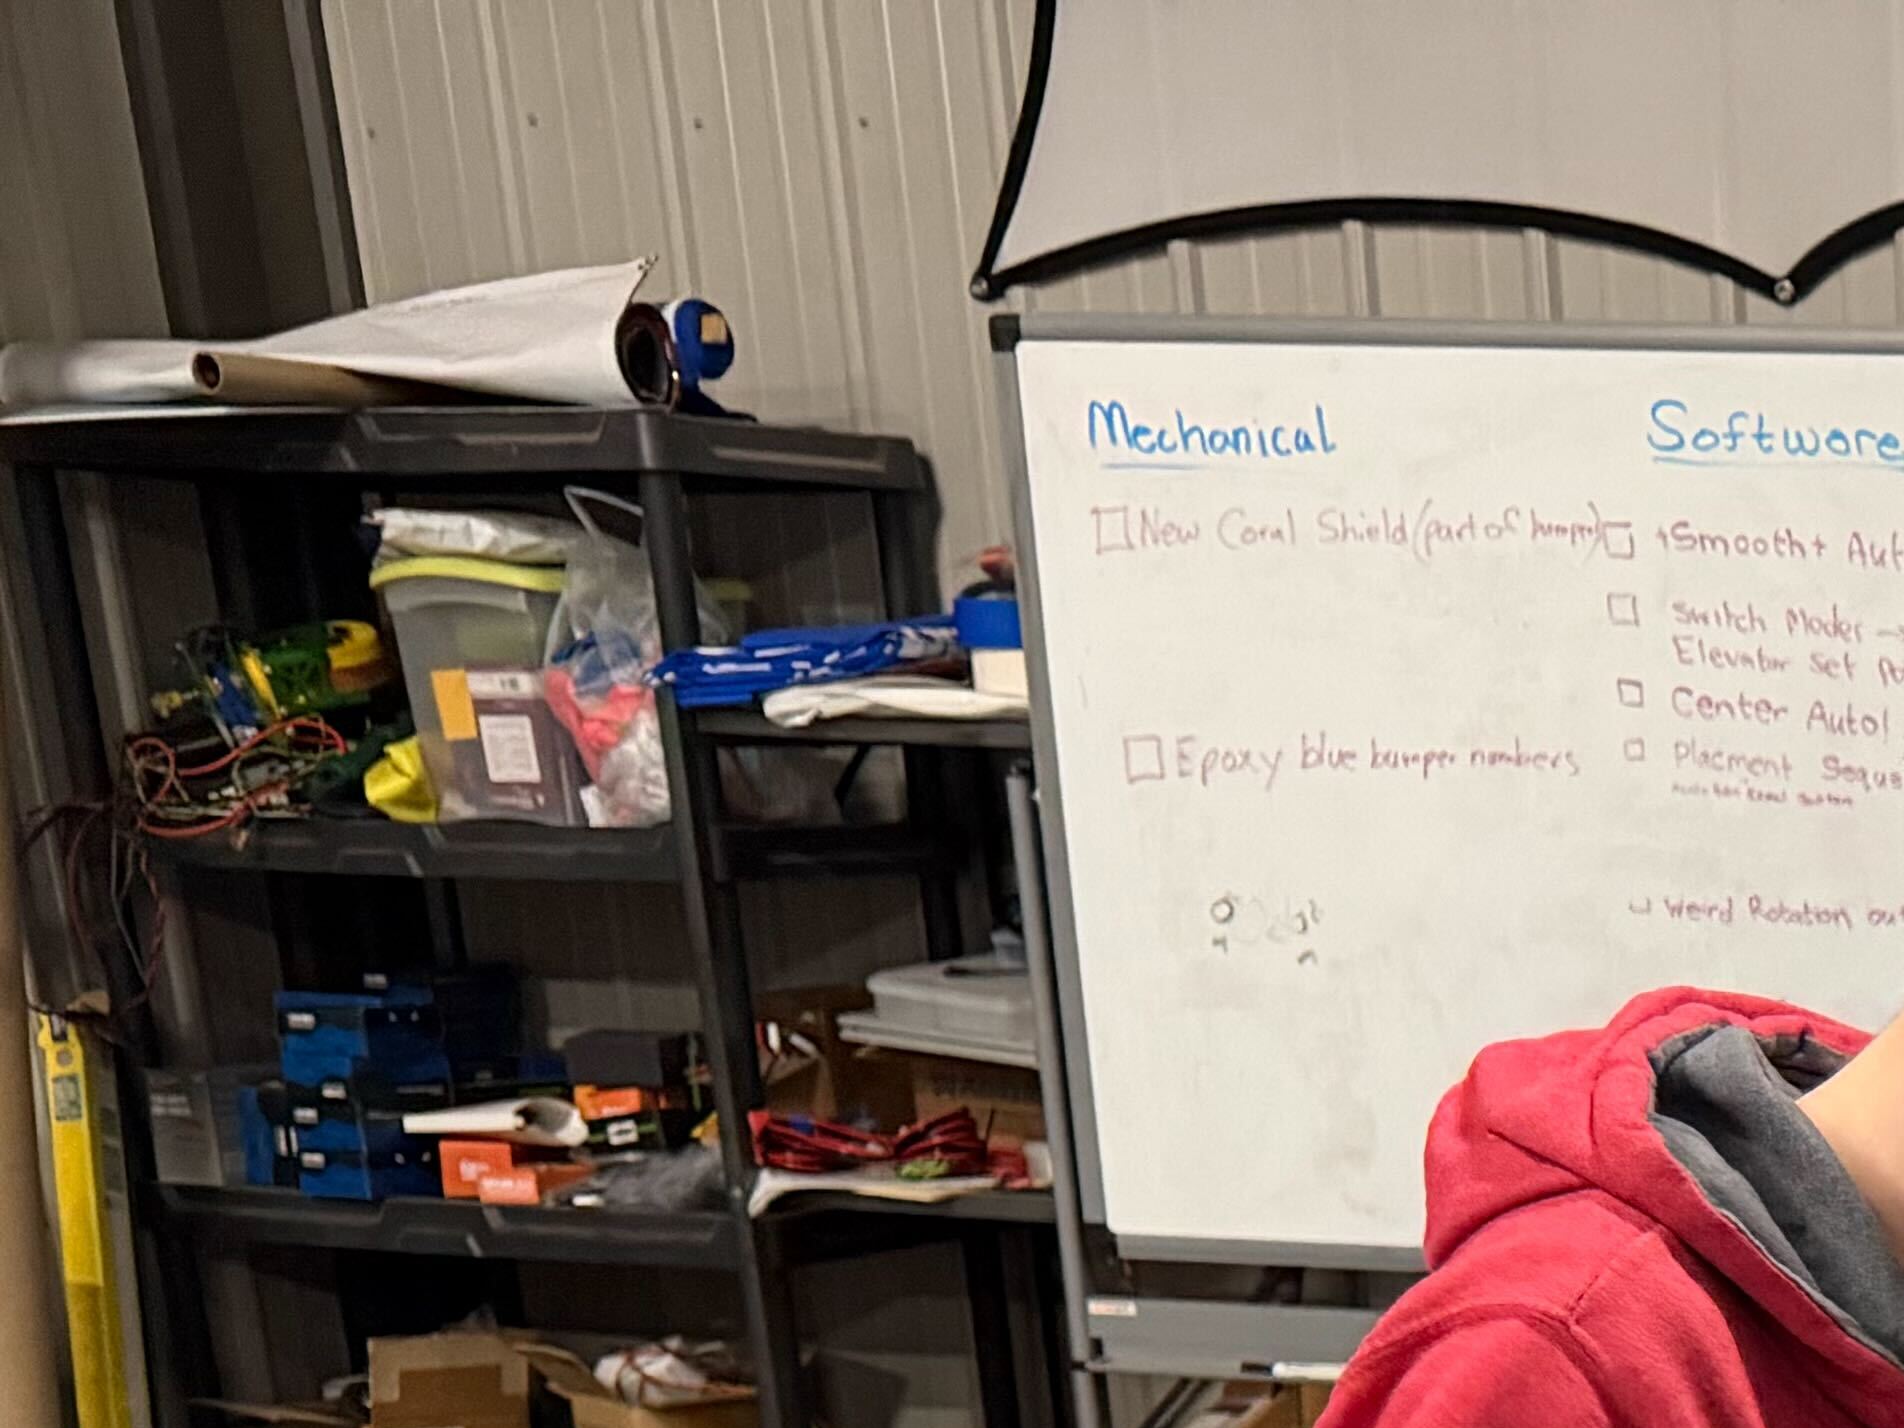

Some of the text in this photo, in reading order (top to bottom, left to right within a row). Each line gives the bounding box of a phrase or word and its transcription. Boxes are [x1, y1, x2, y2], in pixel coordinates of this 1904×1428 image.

[1088, 400, 1337, 457] Mechanical
[1140, 506, 1200, 547] New
[1217, 507, 1296, 551] Coral
[1317, 507, 1408, 547] Shield
[1484, 504, 1520, 540] of
[1672, 601, 1766, 635] Switch
[1672, 635, 1791, 674] Elevator
[1671, 686, 1788, 725] Center
[1177, 735, 1282, 792] Epoxy
[1301, 730, 1358, 772] blue
[1371, 736, 1456, 779] bumper
[1664, 897, 1733, 924] Weird
[1749, 894, 1853, 929] Rotation
